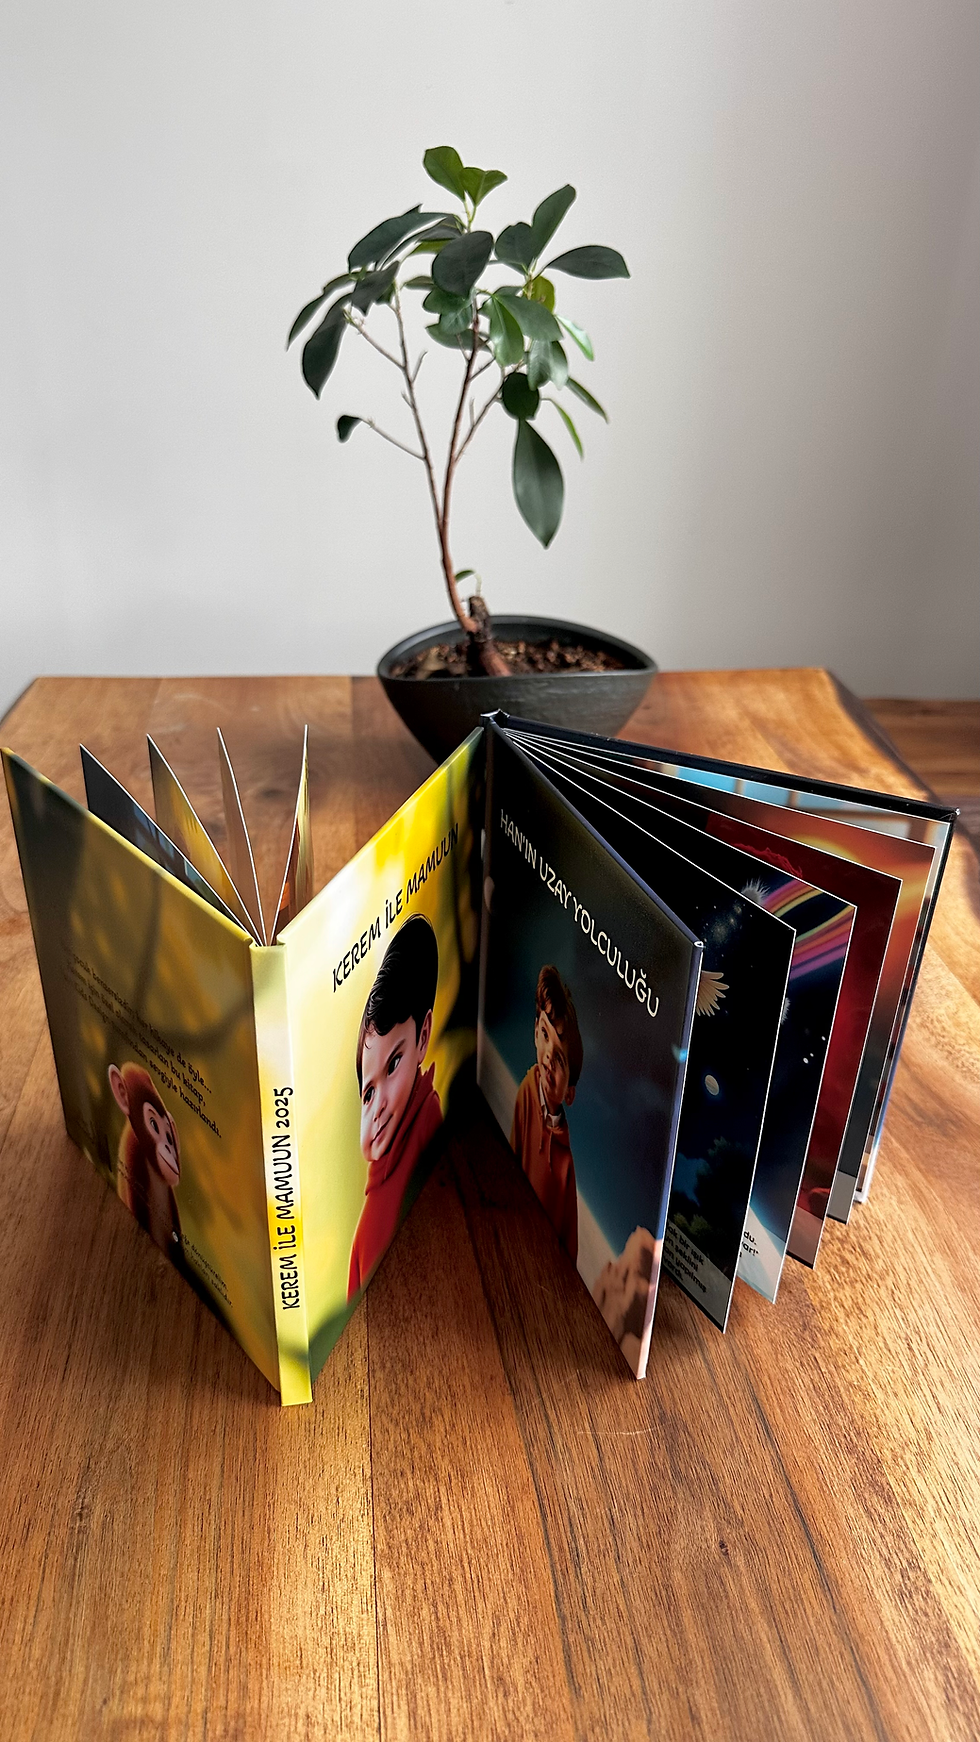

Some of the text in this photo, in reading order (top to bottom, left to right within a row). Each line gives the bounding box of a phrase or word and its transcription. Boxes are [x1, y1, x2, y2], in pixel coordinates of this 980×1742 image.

[333, 823, 459, 993] KEREM İLE MAMUUN
[500, 808, 660, 1018] HAN'IN UZAY YOLCULUĞU
[149, 1060, 178, 1092] sevgiyle
[178, 1086, 222, 1138] hazırlandı.
[170, 1060, 181, 1080] bu
[182, 1072, 206, 1107] kitap,
[176, 1052, 186, 1068] de
[188, 1062, 212, 1094] öyle...
[271, 1086, 300, 1310] KEREM İLE MAMUUN 2025
